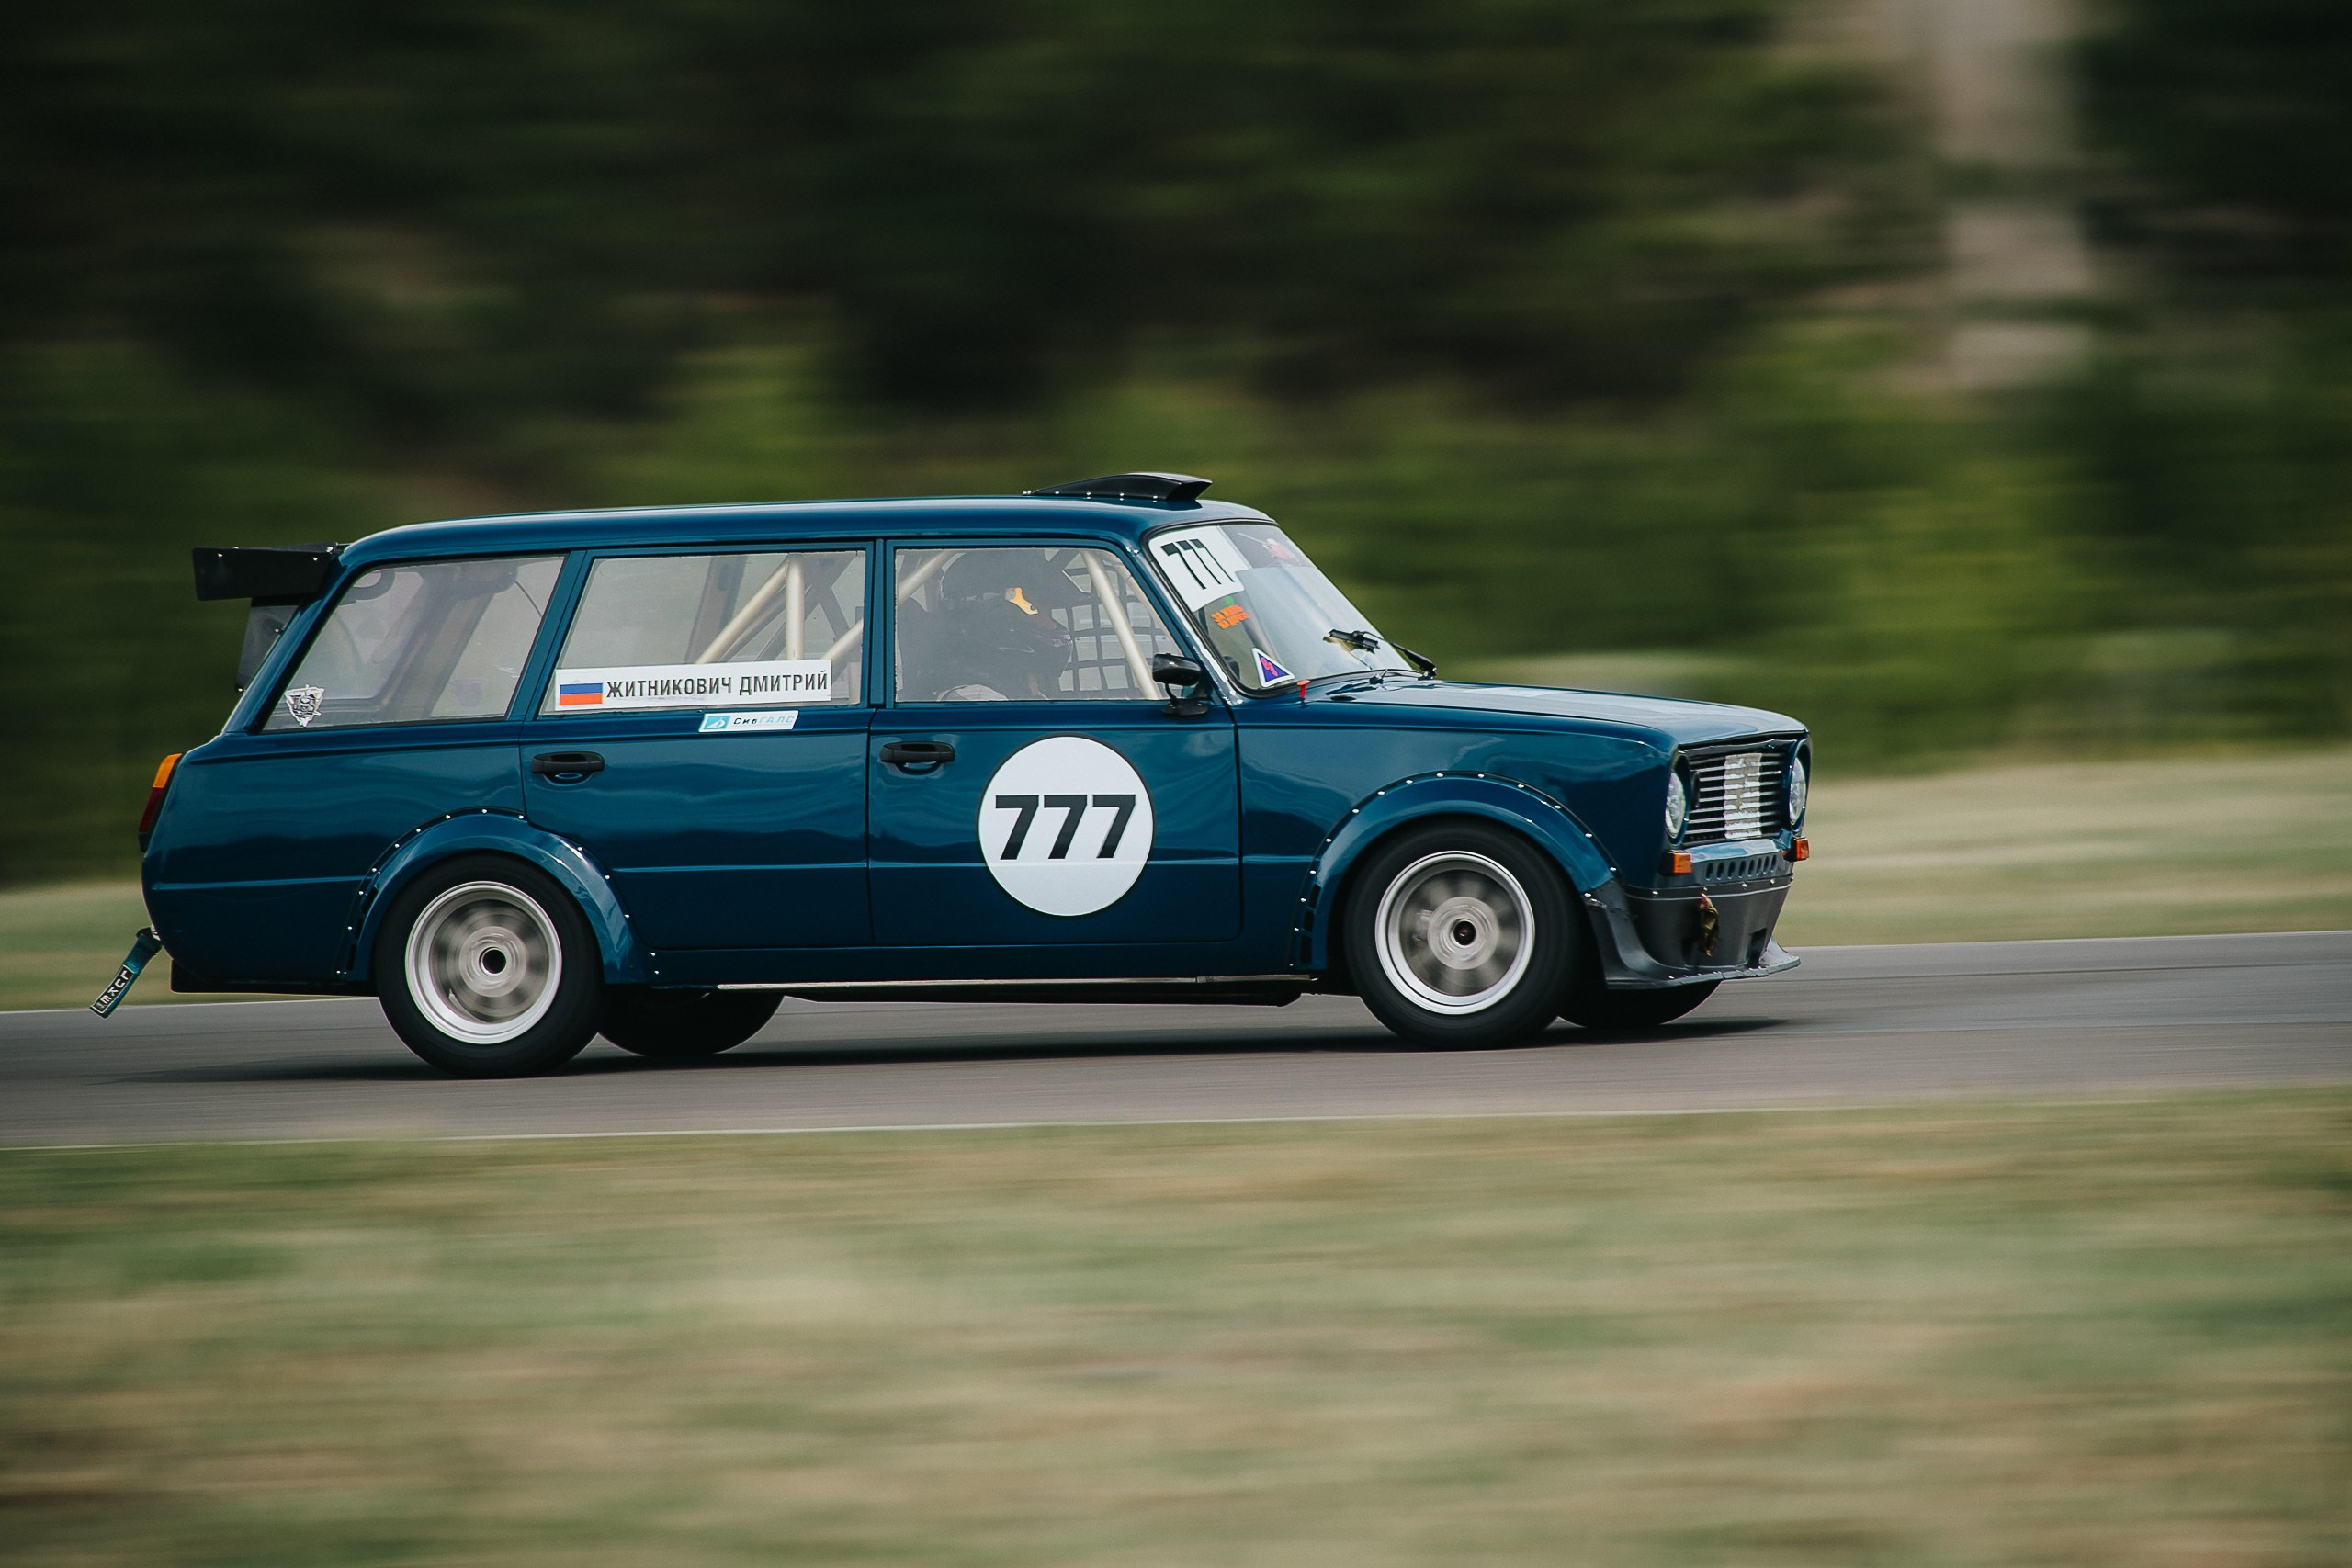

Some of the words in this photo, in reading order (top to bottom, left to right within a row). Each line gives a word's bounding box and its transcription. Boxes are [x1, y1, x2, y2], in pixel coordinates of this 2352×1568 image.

[1159, 538, 1235, 590] 777
[606, 676, 732, 698] ЖИТНИКОВИЧ
[739, 669, 828, 695] ДМИТРИЙ
[995, 794, 1136, 861] 777
